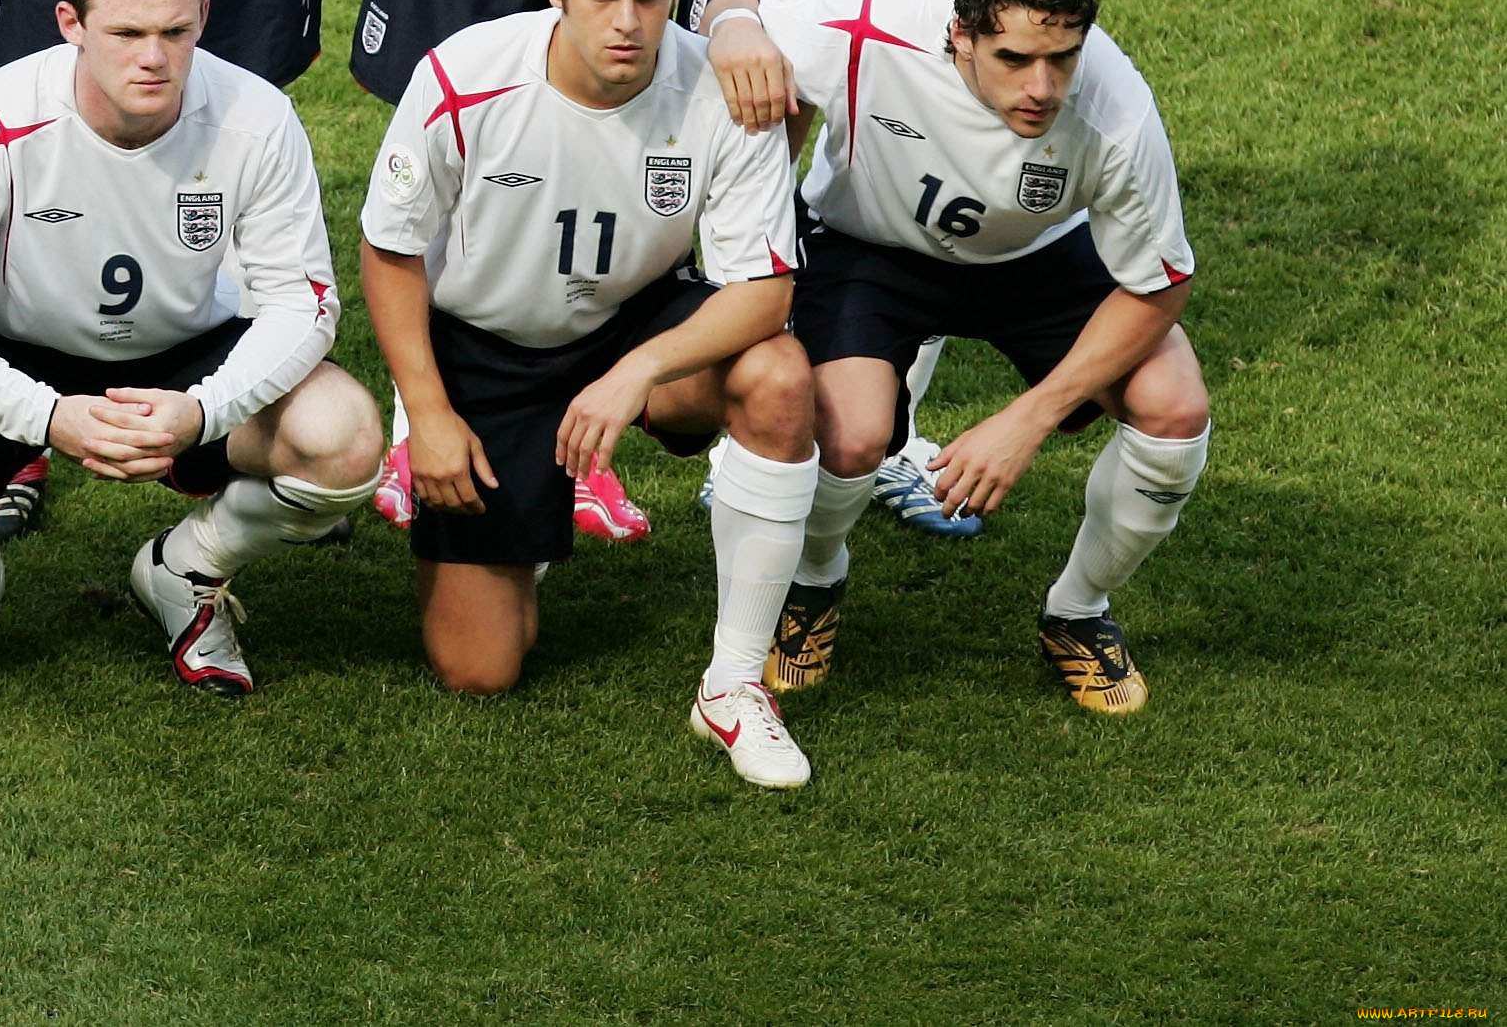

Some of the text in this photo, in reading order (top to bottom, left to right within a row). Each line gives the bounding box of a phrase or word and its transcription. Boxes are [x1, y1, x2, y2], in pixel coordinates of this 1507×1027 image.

[647, 157, 690, 167] ENGLAND
[1024, 164, 1066, 175] ENGLAND
[179, 194, 221, 203] ENGLAND
[914, 173, 986, 238] 16
[555, 209, 617, 275] 11
[98, 253, 144, 316] 9
